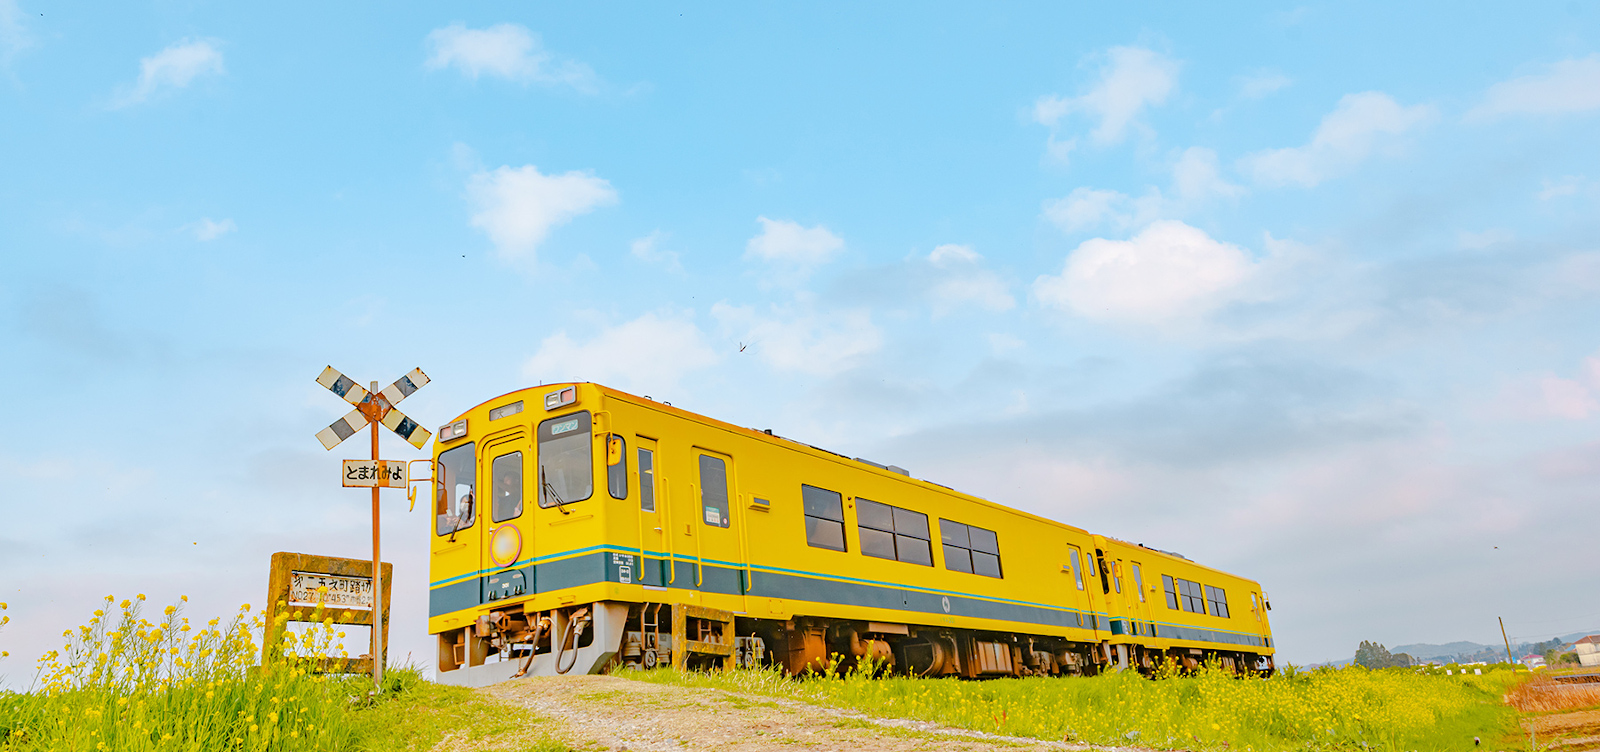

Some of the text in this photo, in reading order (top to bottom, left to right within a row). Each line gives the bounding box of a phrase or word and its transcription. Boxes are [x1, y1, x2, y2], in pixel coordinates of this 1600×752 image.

[552, 421, 578, 434] ワンマン
[346, 465, 403, 481] とまれみよ
